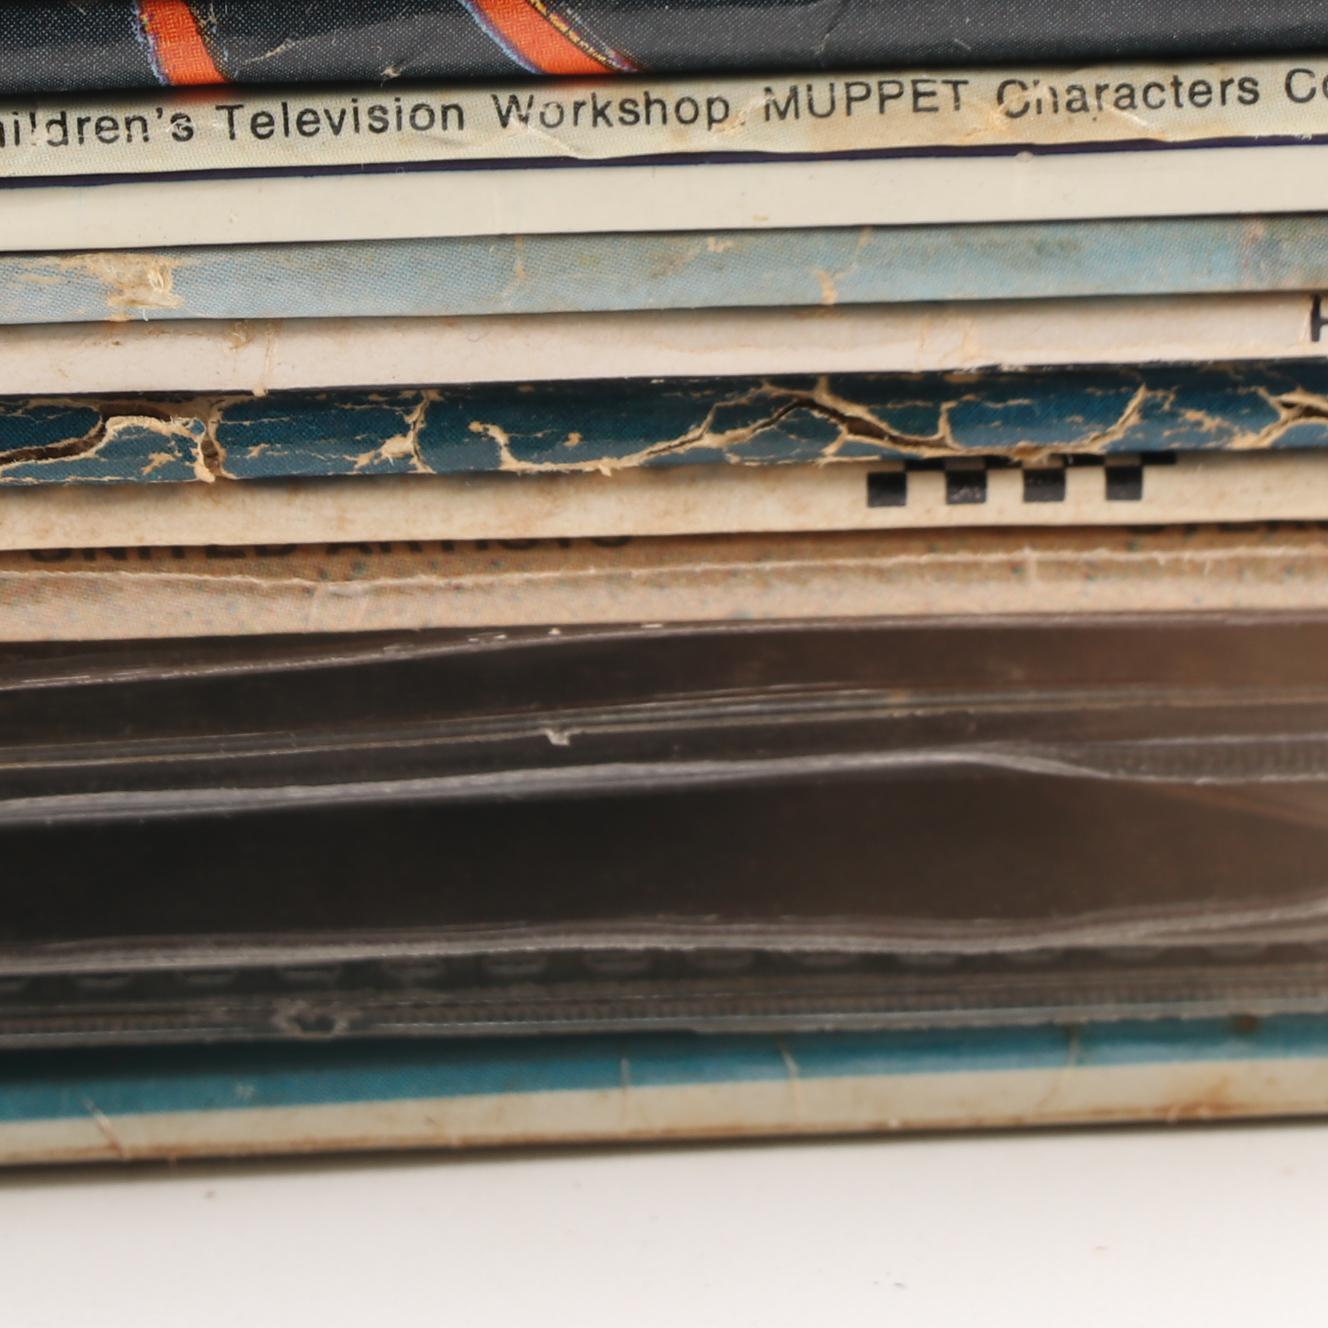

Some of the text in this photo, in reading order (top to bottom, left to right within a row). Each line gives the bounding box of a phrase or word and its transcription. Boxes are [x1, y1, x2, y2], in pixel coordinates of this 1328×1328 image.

[215, 97, 465, 142] Television
[764, 78, 971, 122] MUPPET
[996, 75, 1261, 122] Characters
